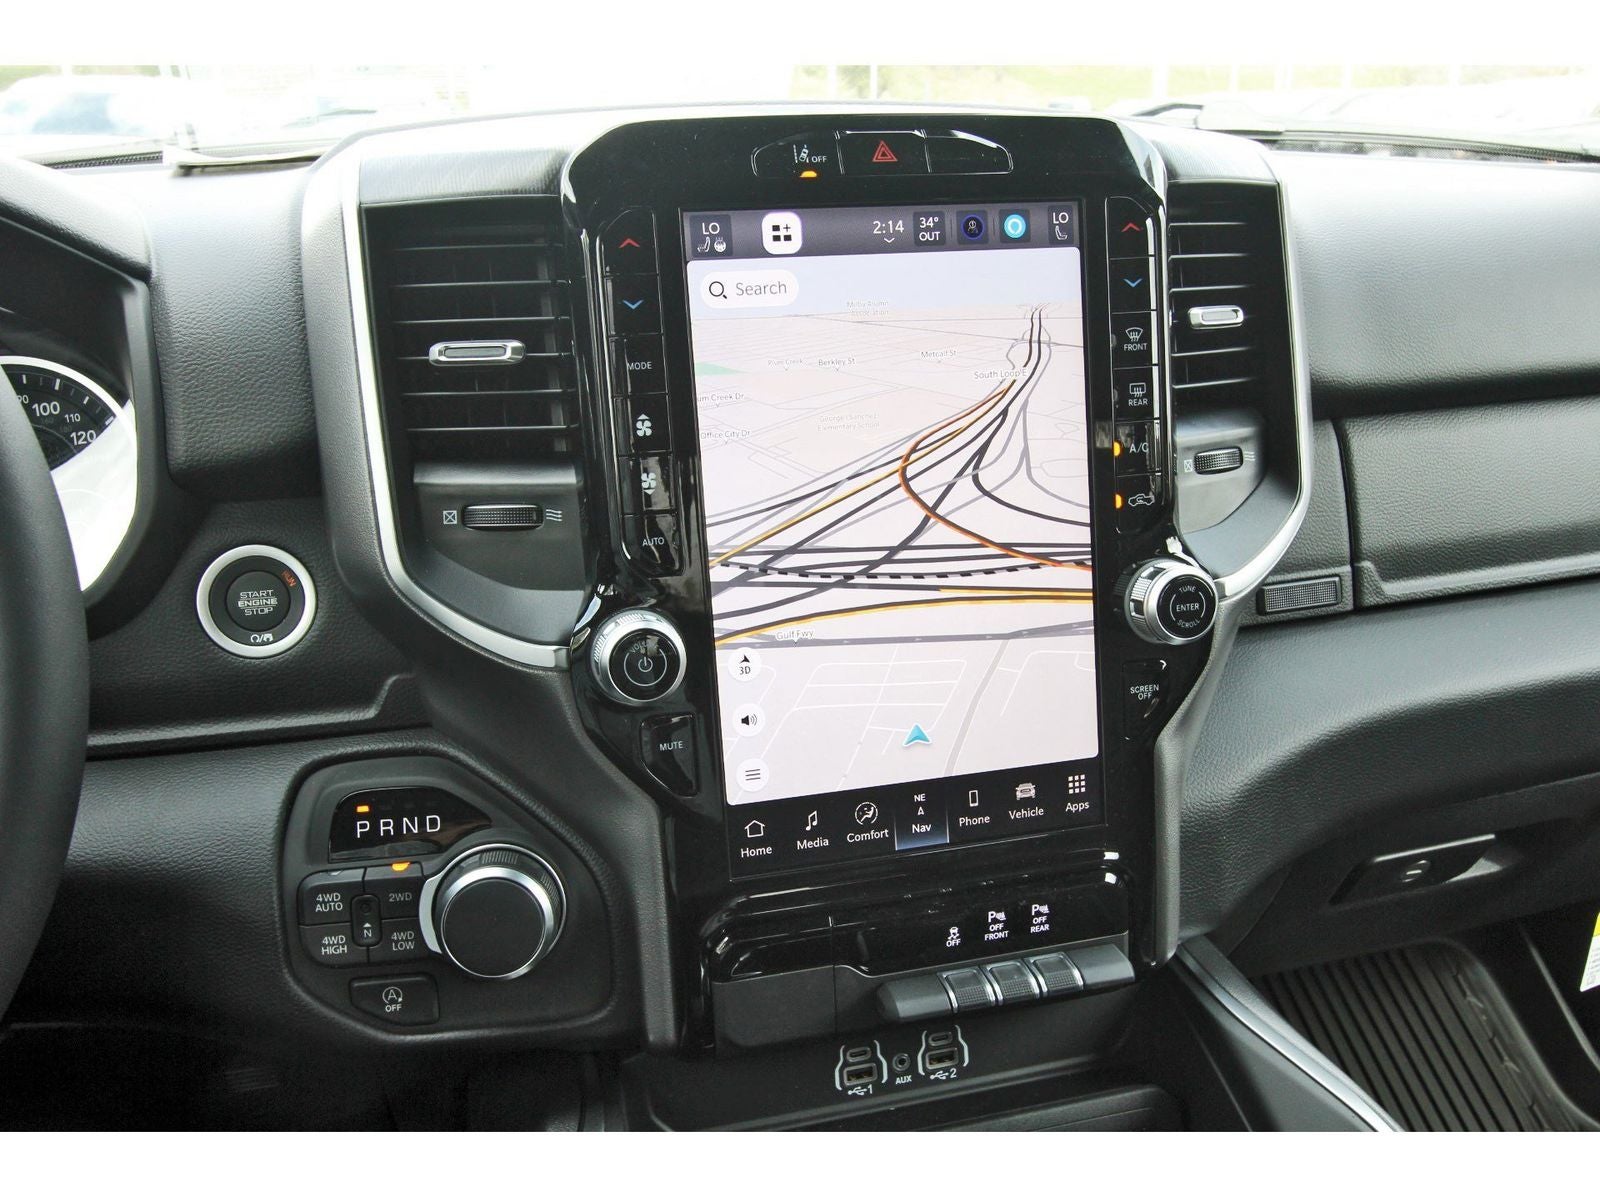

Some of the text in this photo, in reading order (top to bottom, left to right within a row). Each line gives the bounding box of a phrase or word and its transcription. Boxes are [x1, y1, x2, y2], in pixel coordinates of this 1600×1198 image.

[811, 155, 828, 163] OFF
[1052, 211, 1070, 225] LO
[702, 222, 721, 236] LO
[872, 220, 905, 234] 2:14
[919, 231, 941, 242] OUT
[735, 279, 788, 299] Search
[1124, 342, 1148, 352] FRONT
[627, 361, 653, 371] MODE
[818, 357, 857, 368] Berkley St
[974, 369, 998, 379] South
[1000, 369, 1020, 379] Loop
[711, 393, 733, 402] Creek
[735, 392, 744, 401] Dr
[1129, 397, 1149, 407] REAR
[32, 401, 61, 417] 100
[65, 413, 81, 423] 110
[70, 429, 97, 446] 120
[701, 430, 751, 441] Office City Dr
[1129, 442, 1149, 454] A/C
[642, 537, 665, 547] AUTO
[240, 589, 274, 599] START
[1178, 585, 1197, 593] TUNE
[238, 597, 278, 608] ENGINE
[1176, 602, 1200, 612] ENTER
[245, 606, 273, 616] STOP
[1176, 618, 1201, 630] SCROLL
[776, 631, 814, 641] Gulf Fwy
[739, 666, 751, 676] 3D
[1130, 684, 1159, 694] SCREEN
[1137, 691, 1152, 701] OFF
[659, 741, 684, 752] MUTE
[914, 793, 926, 802] NE
[1065, 800, 1090, 813] Apps
[1009, 806, 1044, 821] Vehicle
[356, 814, 441, 839] P R N D
[959, 814, 991, 828] Phone
[912, 822, 931, 834] Nav
[847, 829, 889, 844] Comfort
[797, 837, 829, 850] Media
[741, 846, 773, 858] Home
[316, 892, 341, 902] 4WD
[388, 891, 413, 902] 2WD
[315, 902, 343, 913] AUTO
[1032, 915, 1047, 925] OFF
[989, 923, 1004, 932] OFF
[1030, 924, 1050, 934] REAR
[363, 929, 372, 938] N
[391, 931, 415, 941] 4WD
[984, 930, 1009, 941] FRONT
[322, 935, 346, 945] 4WD
[946, 938, 961, 948] OFF
[321, 945, 348, 956] HIGH
[392, 941, 415, 951] LOW
[385, 1004, 402, 1013] OFF
[950, 1067, 957, 1078] 2
[895, 1074, 912, 1085] AUX
[867, 1083, 873, 1094] 1
